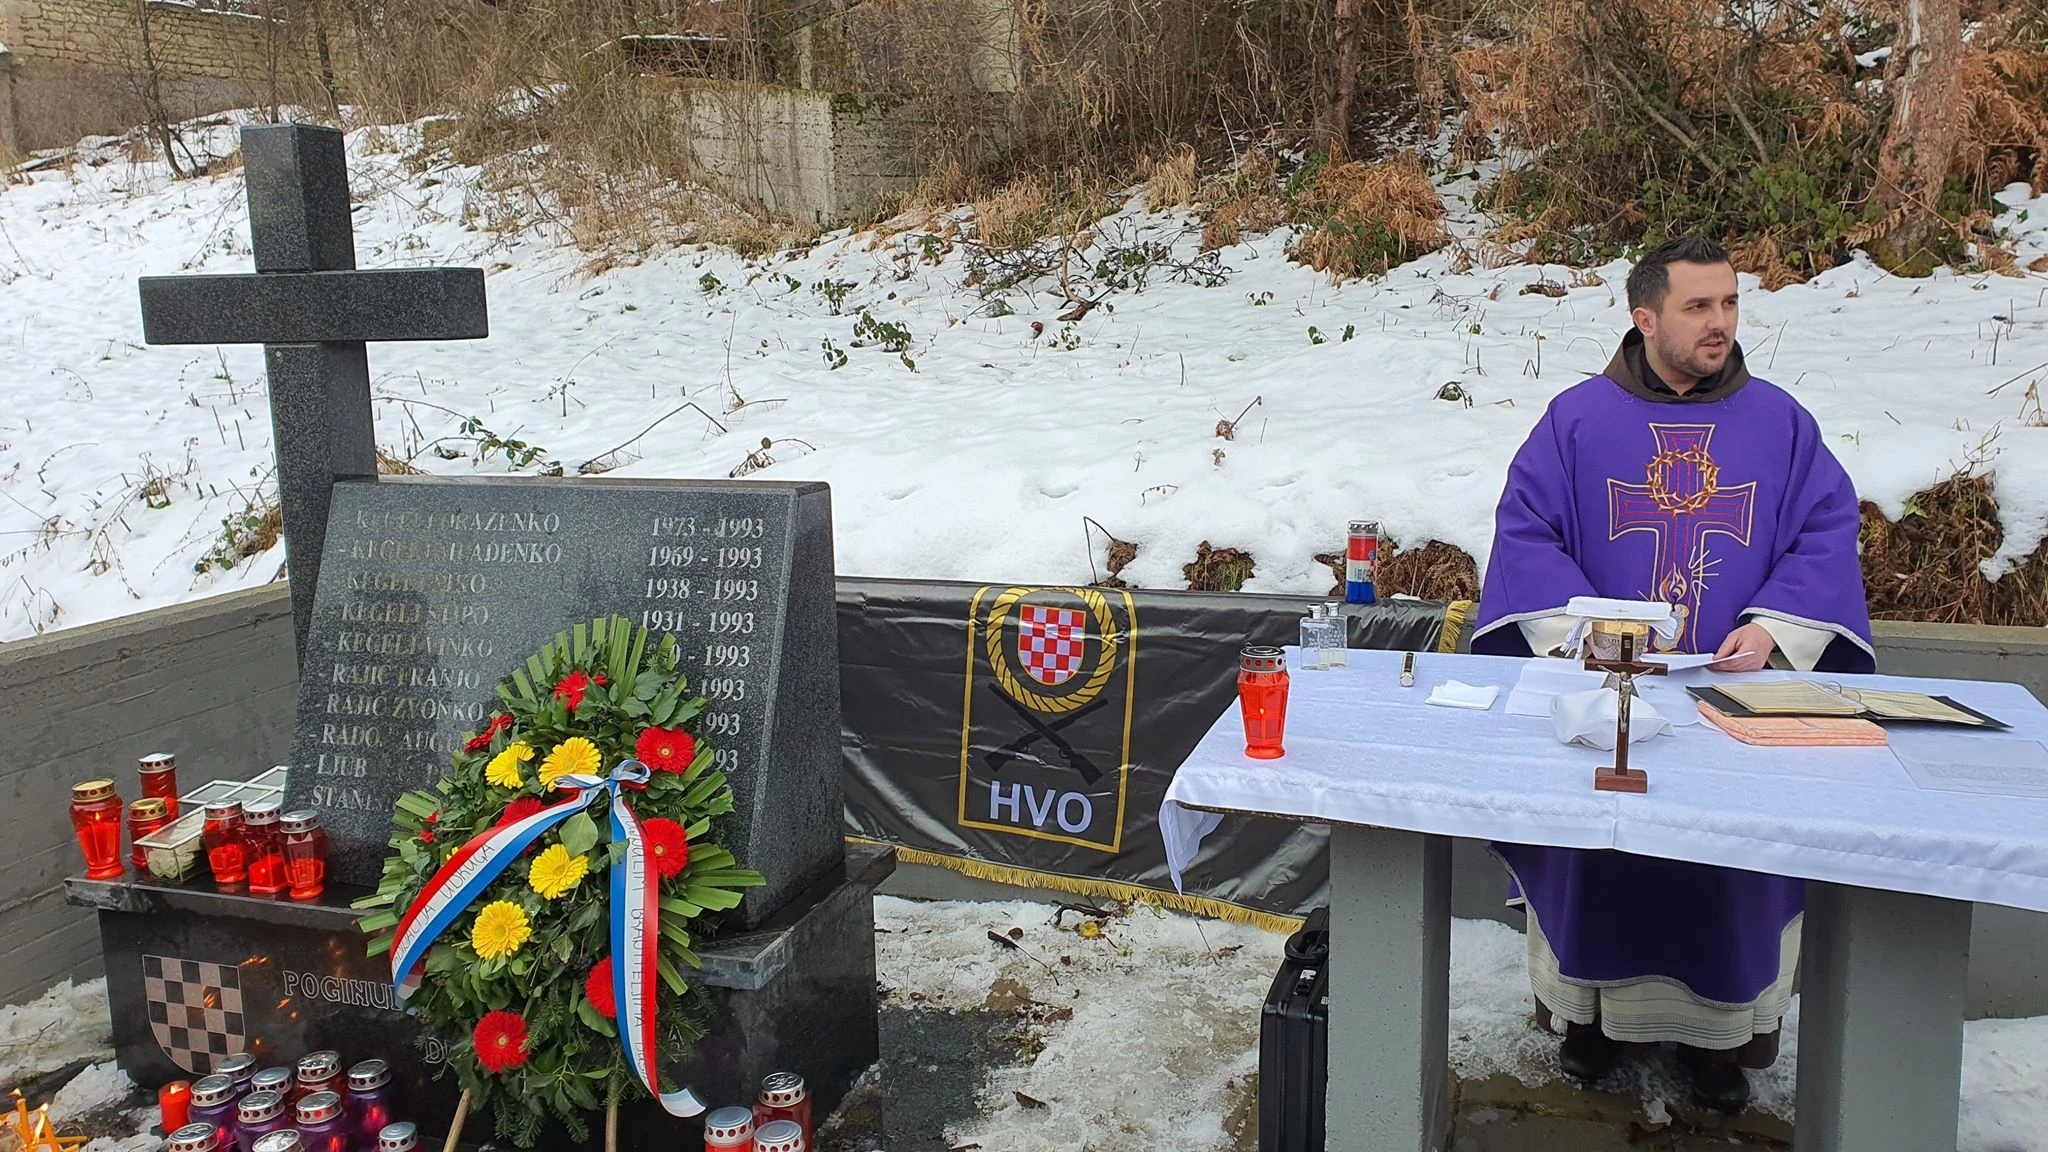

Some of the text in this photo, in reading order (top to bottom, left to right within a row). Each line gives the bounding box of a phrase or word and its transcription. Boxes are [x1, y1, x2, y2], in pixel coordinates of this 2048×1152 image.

[652, 517, 695, 537] 1973
[717, 517, 763, 539] 1993
[648, 546, 694, 567] 1969
[718, 547, 761, 569] 1993
[645, 578, 690, 599] 1938
[712, 579, 758, 601] 1993
[642, 610, 684, 631] 1931
[709, 611, 754, 634] 1993
[704, 645, 750, 667] 1993
[701, 677, 745, 701] 1993
[705, 712, 741, 736] 993
[714, 748, 739, 772] 93
[990, 780, 1093, 834] HVO
[440, 843, 496, 900] UDRUGA
[283, 970, 403, 1012] POGINUL
